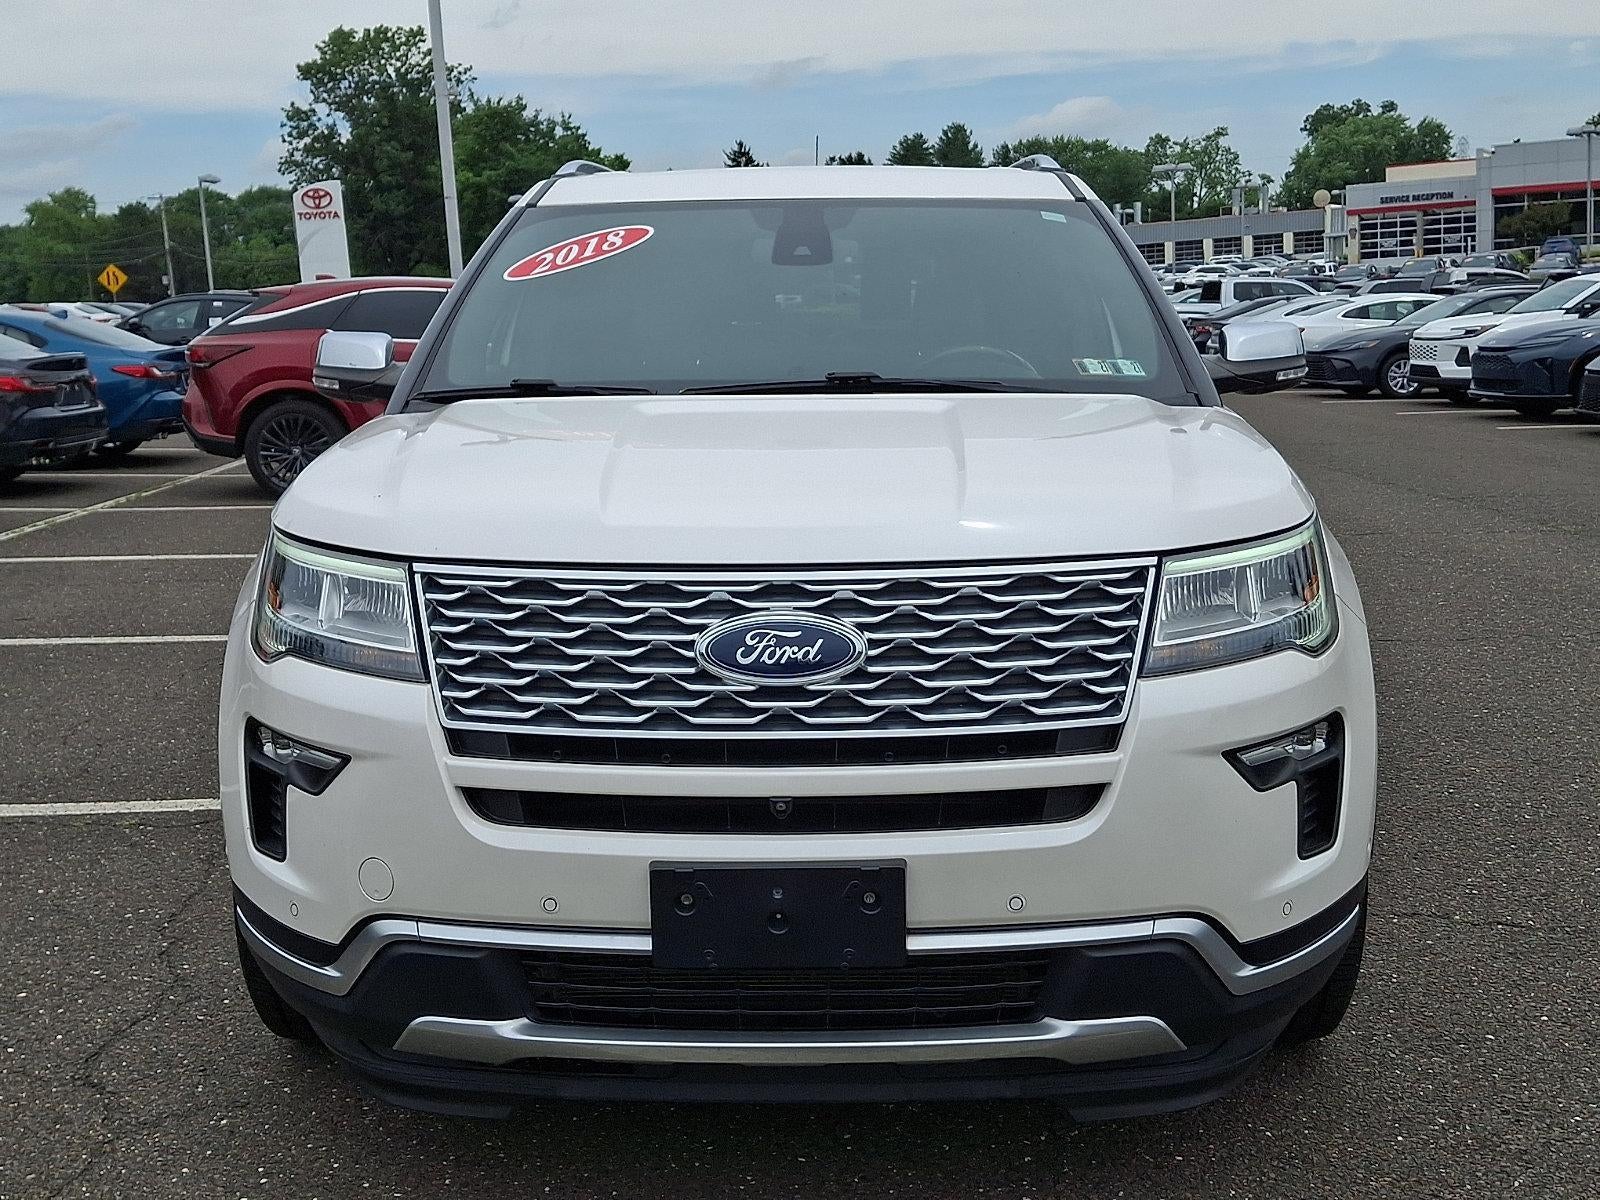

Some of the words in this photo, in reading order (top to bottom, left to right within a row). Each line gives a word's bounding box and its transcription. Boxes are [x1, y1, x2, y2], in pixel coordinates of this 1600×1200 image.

[1380, 196, 1410, 204] SERVICE
[1412, 191, 1454, 201] RECEPTION
[297, 211, 340, 221] TOYOTA
[530, 230, 626, 276] 2018
[736, 629, 824, 664] Ford
